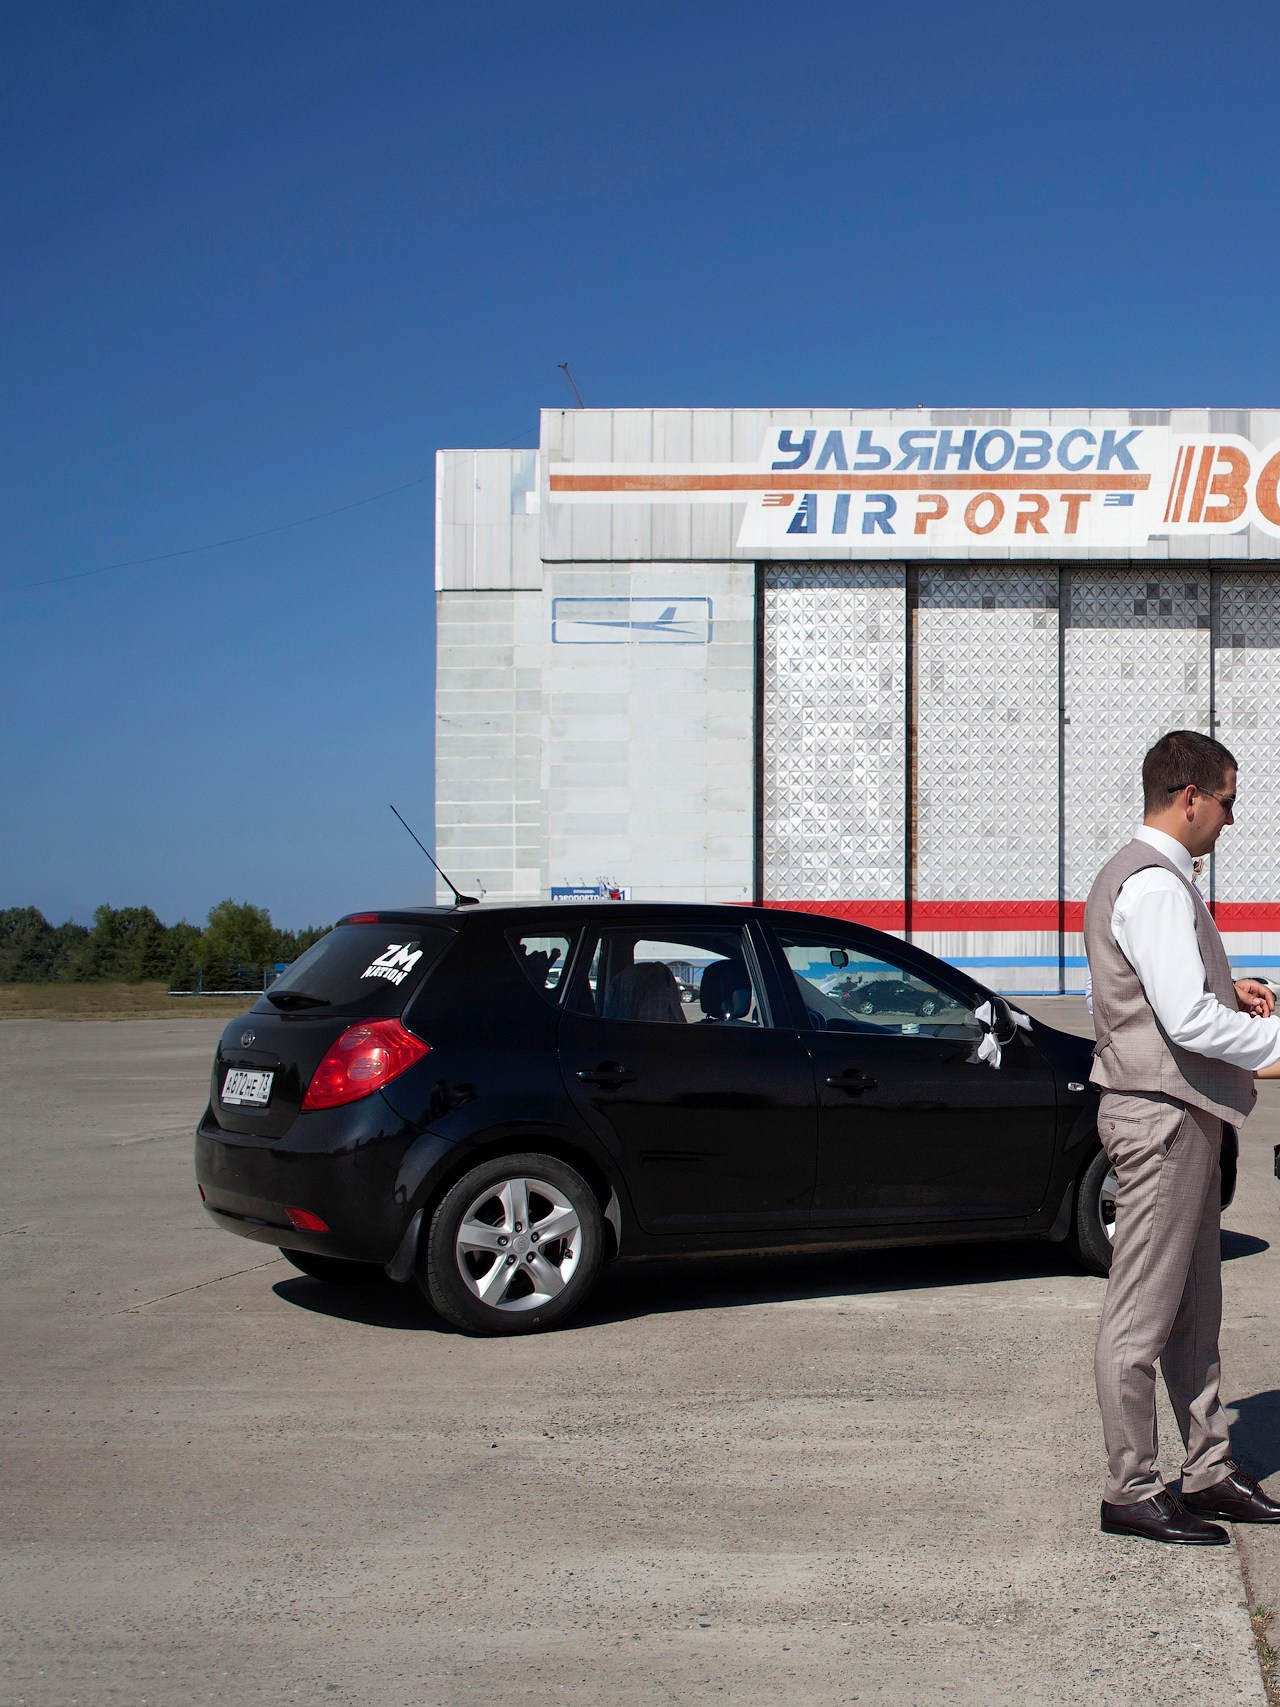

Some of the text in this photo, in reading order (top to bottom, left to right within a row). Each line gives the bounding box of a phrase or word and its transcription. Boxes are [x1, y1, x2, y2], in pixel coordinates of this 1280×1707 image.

[771, 428, 1145, 471] УЛЬЯНОВСК
[786, 491, 1092, 535] AIRPORT
[360, 965, 409, 986] NATION
[371, 942, 424, 973] ZM
